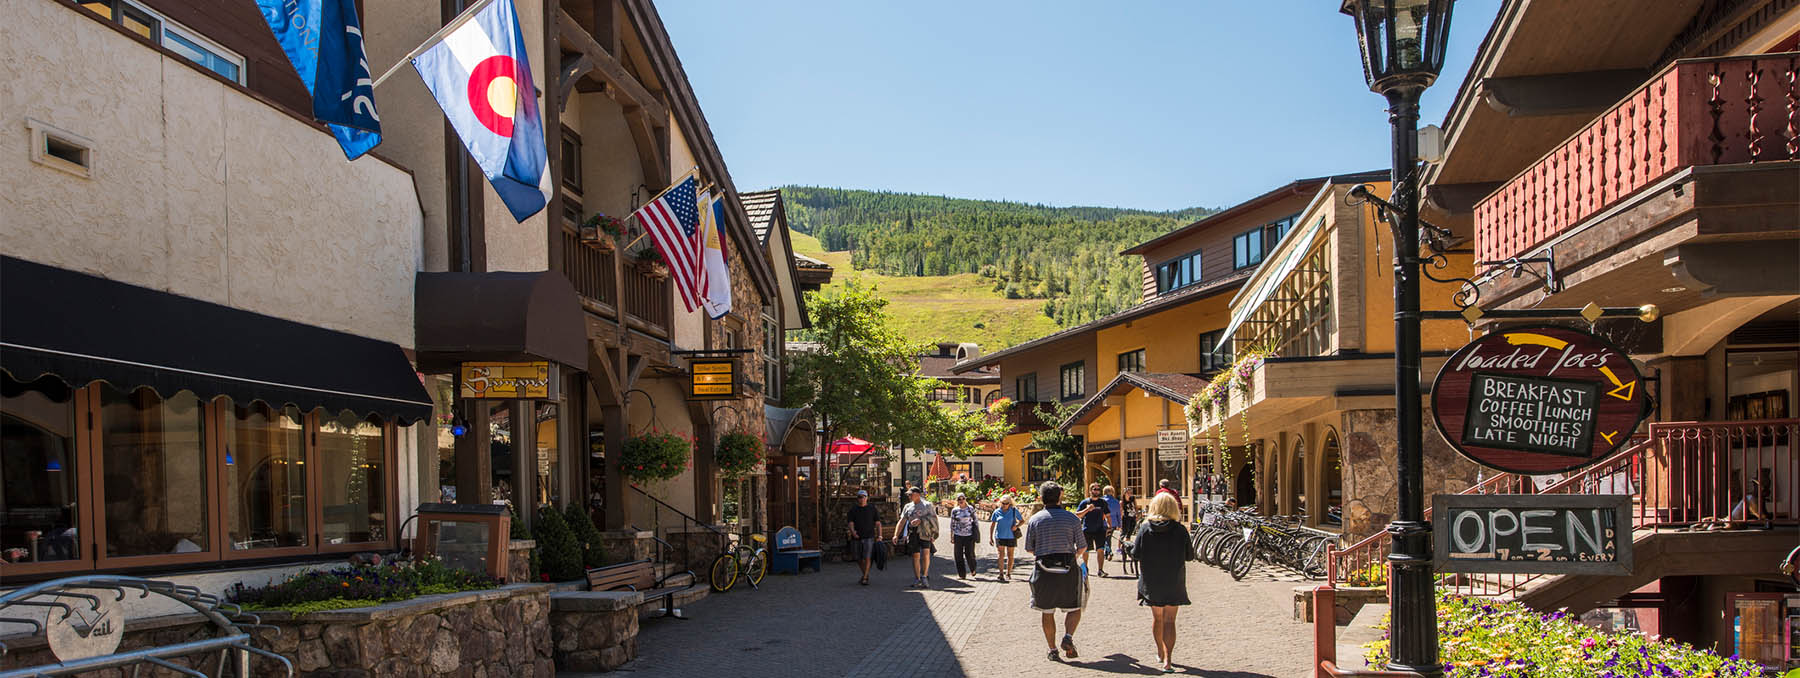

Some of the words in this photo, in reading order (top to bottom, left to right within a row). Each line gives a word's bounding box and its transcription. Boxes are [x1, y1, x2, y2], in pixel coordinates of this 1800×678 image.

[1547, 344, 1615, 377] Joe's
[1483, 378, 1587, 406] BREAKFAST
[1479, 398, 1535, 417] COFFEE
[1544, 406, 1592, 421] LUNCH
[1474, 427, 1517, 443] LATE
[1529, 433, 1579, 449] NIGHT
[1490, 414, 1582, 437] SMOOTHIES
[1453, 509, 1603, 555] OPEN
